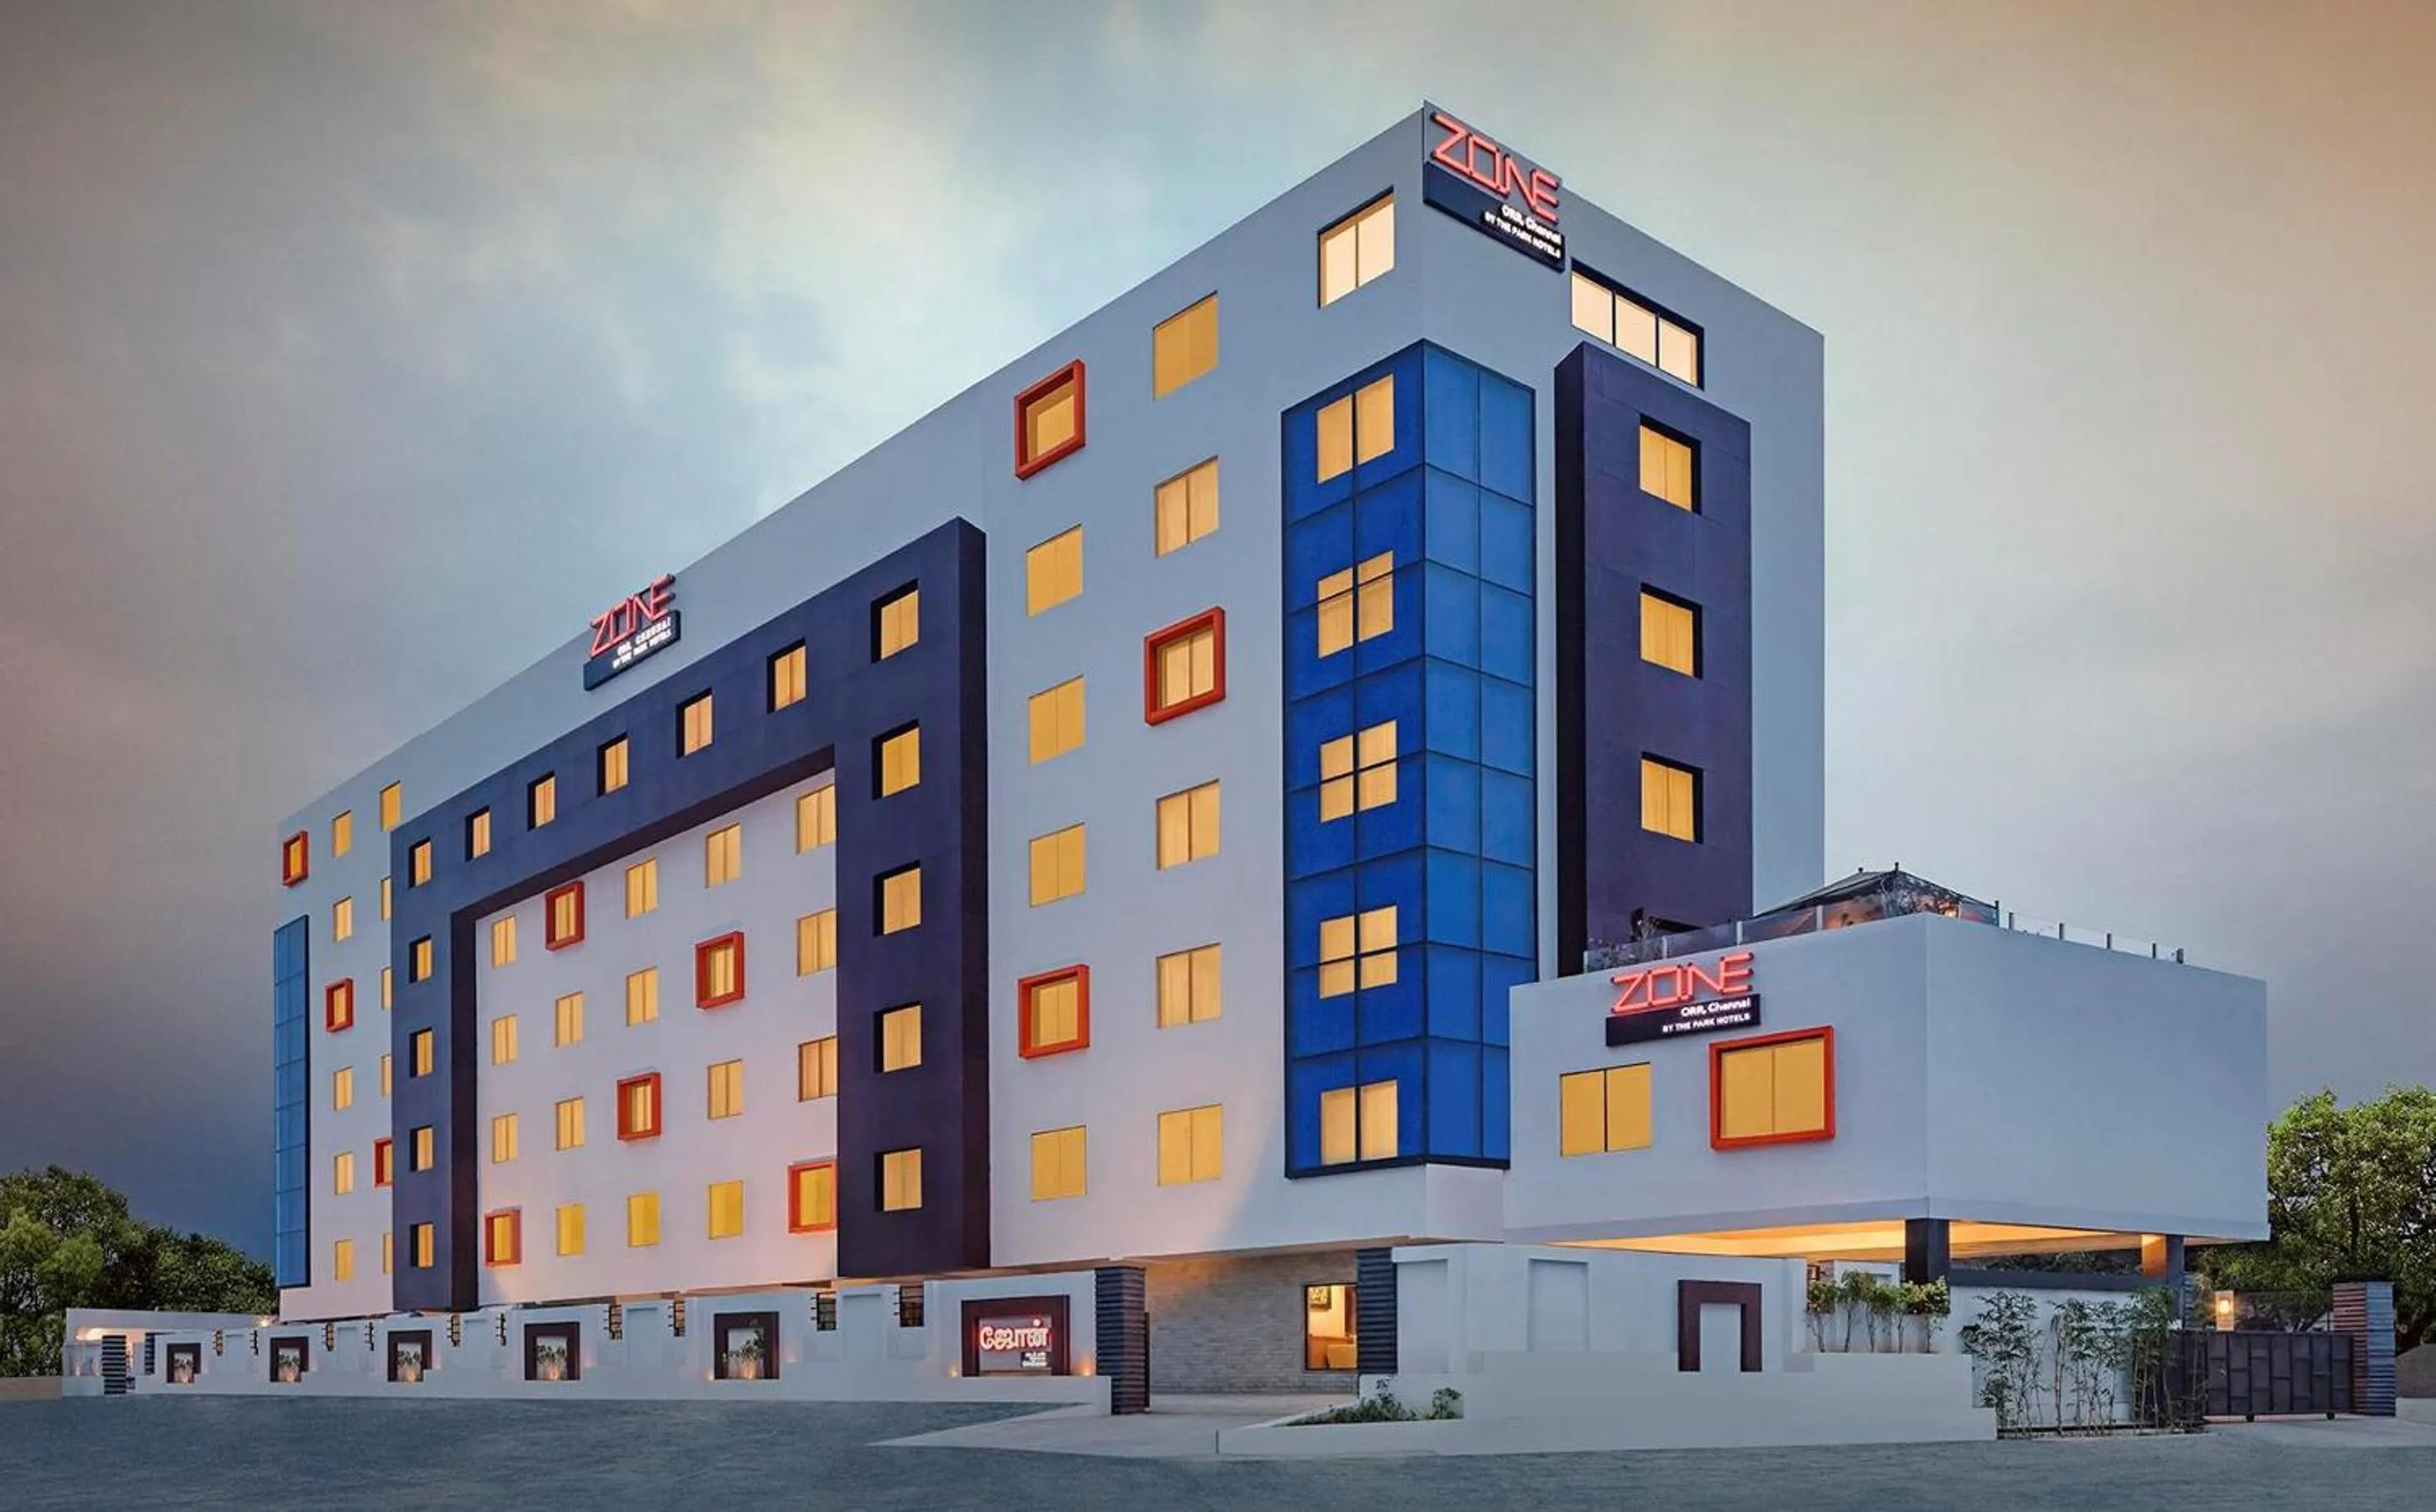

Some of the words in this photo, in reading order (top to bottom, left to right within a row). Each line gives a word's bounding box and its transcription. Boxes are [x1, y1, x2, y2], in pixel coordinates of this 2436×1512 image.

[1431, 113, 1559, 224] ZONE
[591, 574, 675, 659] ZONE
[1611, 952, 1755, 1015] ZONE
[1708, 997, 1751, 1013] Chennai
[1662, 1025, 1673, 1033] BY
[1675, 1021, 1691, 1032] THE
[1693, 1017, 1715, 1029] PARK
[1716, 1013, 1751, 1025] HOTELS
